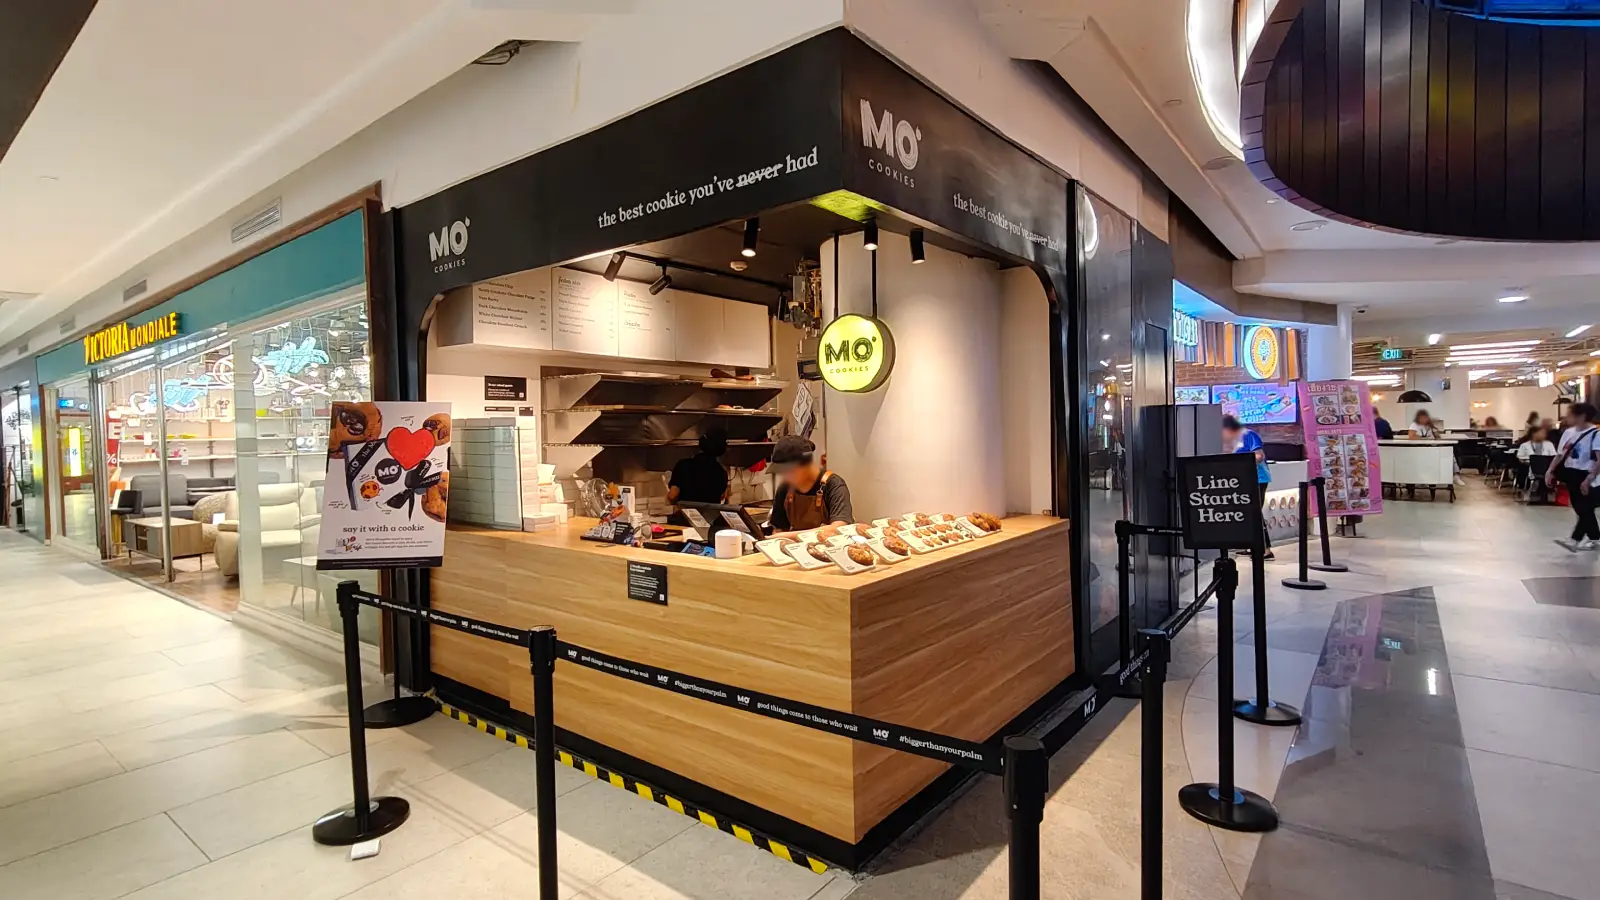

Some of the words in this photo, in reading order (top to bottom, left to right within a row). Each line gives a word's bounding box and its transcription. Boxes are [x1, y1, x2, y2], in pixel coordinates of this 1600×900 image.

[869, 159, 915, 188] COOKIES
[598, 212, 616, 228] the
[619, 203, 644, 222] best
[646, 190, 686, 214] cookie
[689, 176, 734, 205] you've
[736, 164, 783, 187] never
[786, 146, 818, 173] had
[953, 193, 968, 211] the
[969, 198, 986, 219] best
[987, 212, 1008, 230] cookie
[1009, 222, 1028, 240] you've
[1028, 233, 1047, 246] never
[1047, 236, 1059, 251] had
[434, 259, 465, 273] COOKIES
[84, 322, 129, 366] VICTORIA
[130, 312, 177, 349] MONDIALE
[829, 366, 869, 374] COOKIES
[1196, 475, 1239, 489] Line
[1189, 492, 1251, 506] Starts
[1198, 508, 1244, 522] Here
[343, 525, 358, 534] say
[359, 524, 367, 532] it
[369, 524, 388, 532] with
[398, 523, 424, 532] cookie
[757, 702, 770, 710] good
[770, 704, 788, 715] things
[811, 715, 828, 725] those
[829, 720, 842, 728] who
[843, 723, 858, 732] wait
[899, 735, 983, 761] #biggerthanyourpalm
